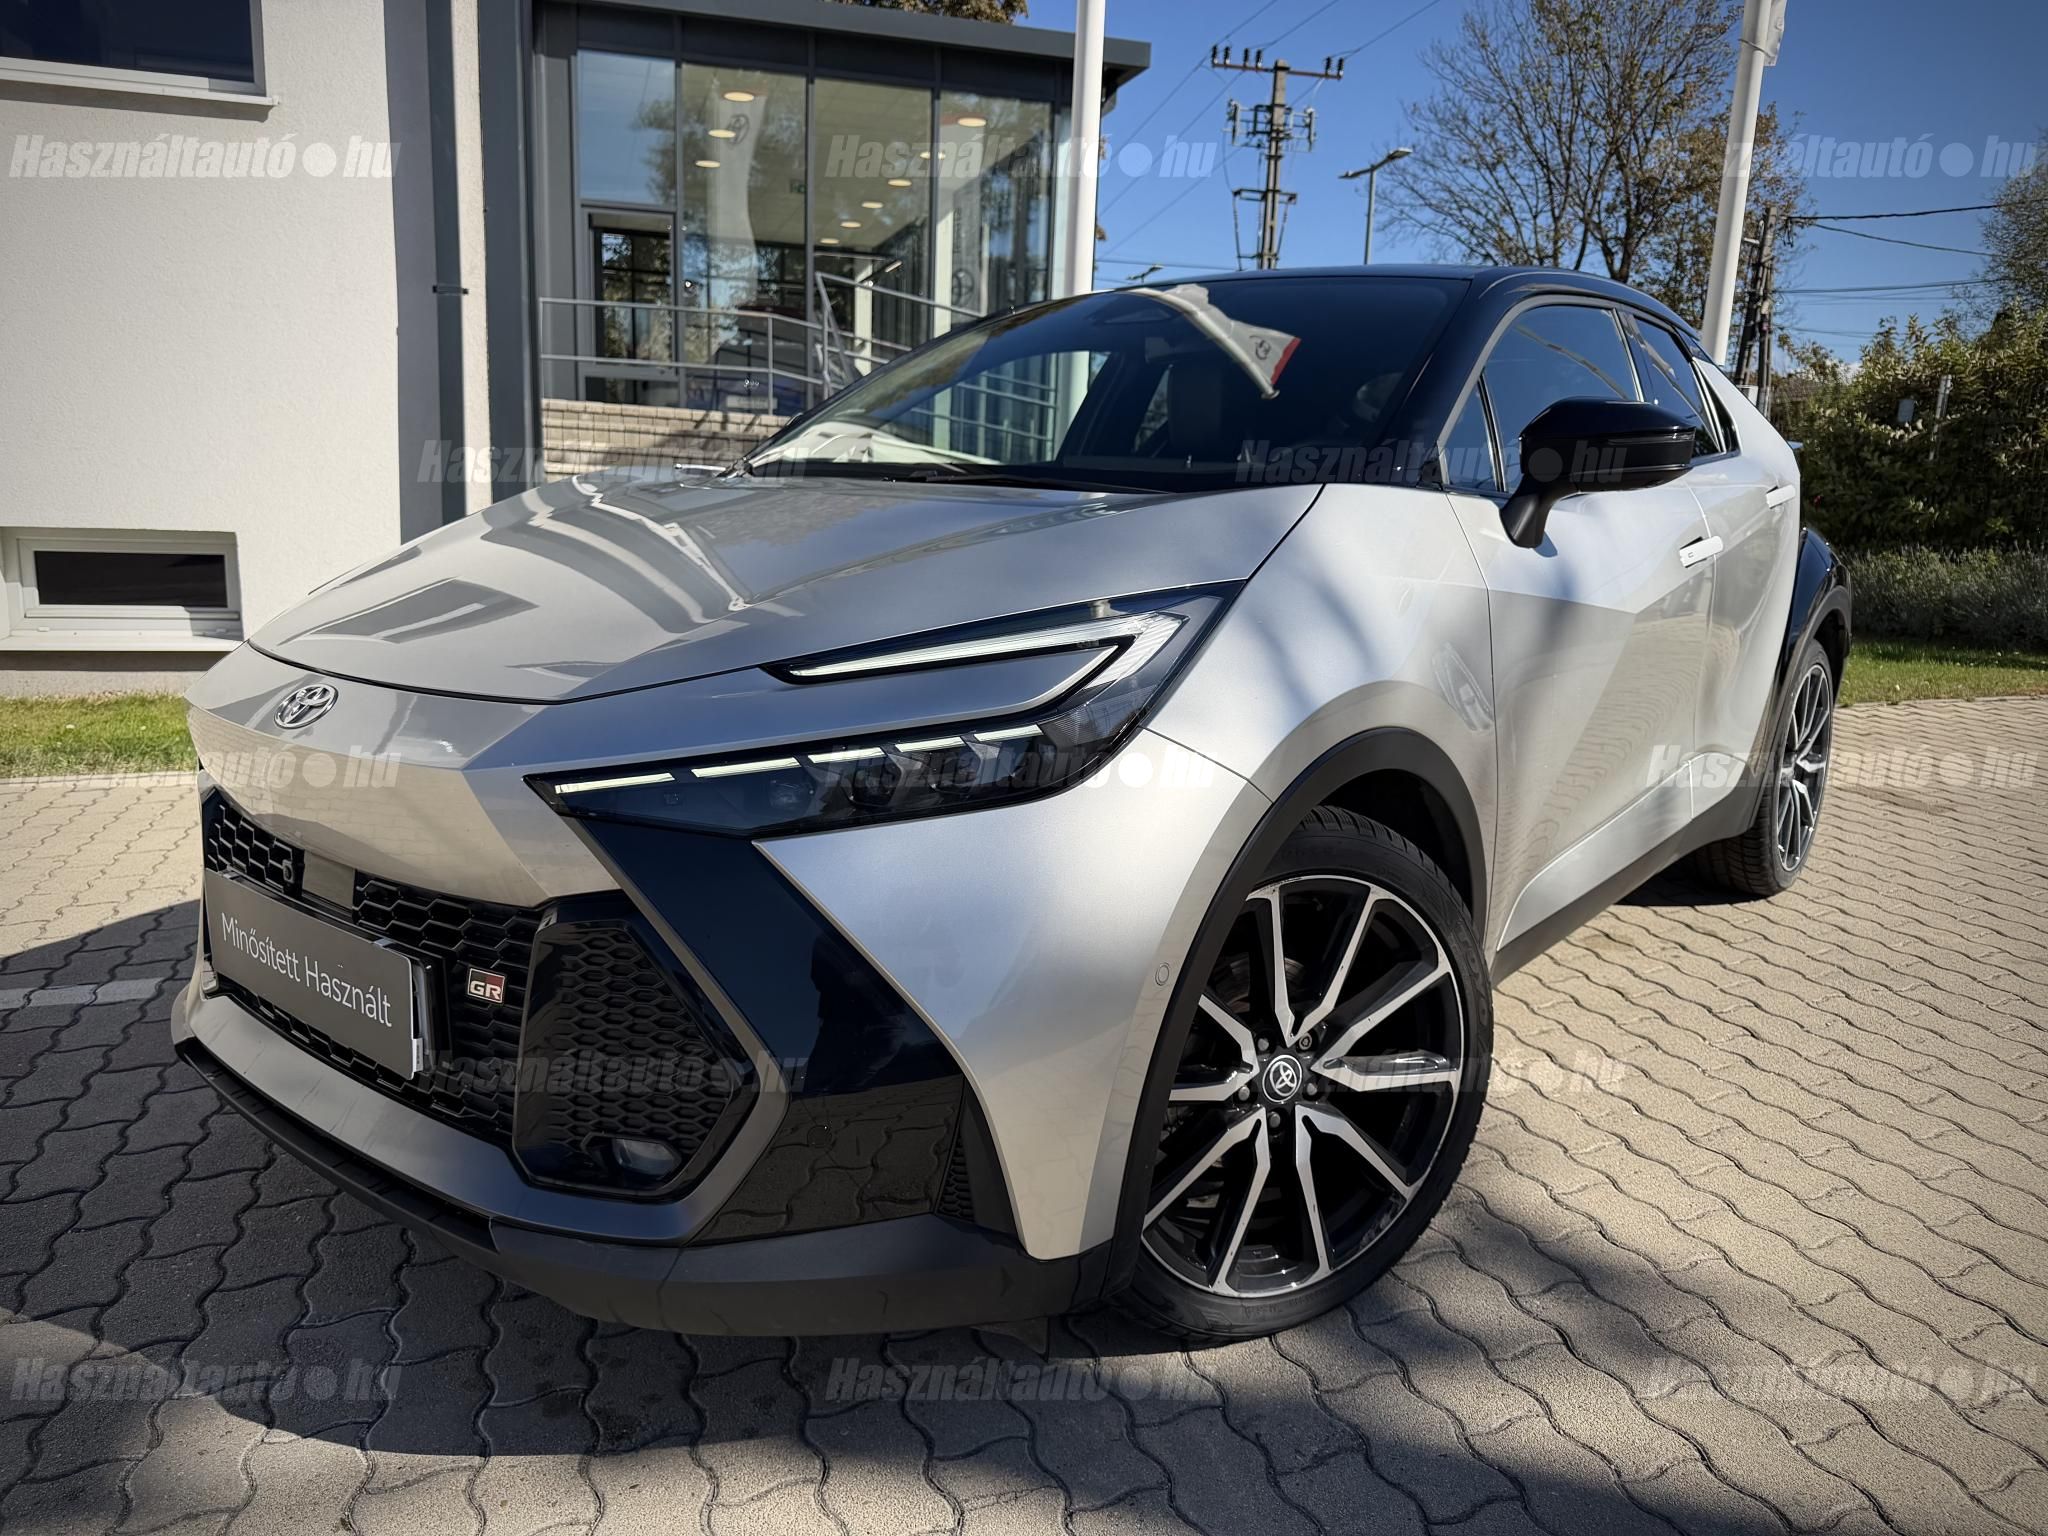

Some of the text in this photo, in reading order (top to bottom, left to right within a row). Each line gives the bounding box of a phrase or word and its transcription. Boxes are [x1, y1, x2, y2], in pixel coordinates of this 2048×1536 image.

[221, 912, 392, 1027] Minősített Használt
[470, 980, 502, 1000] GR
